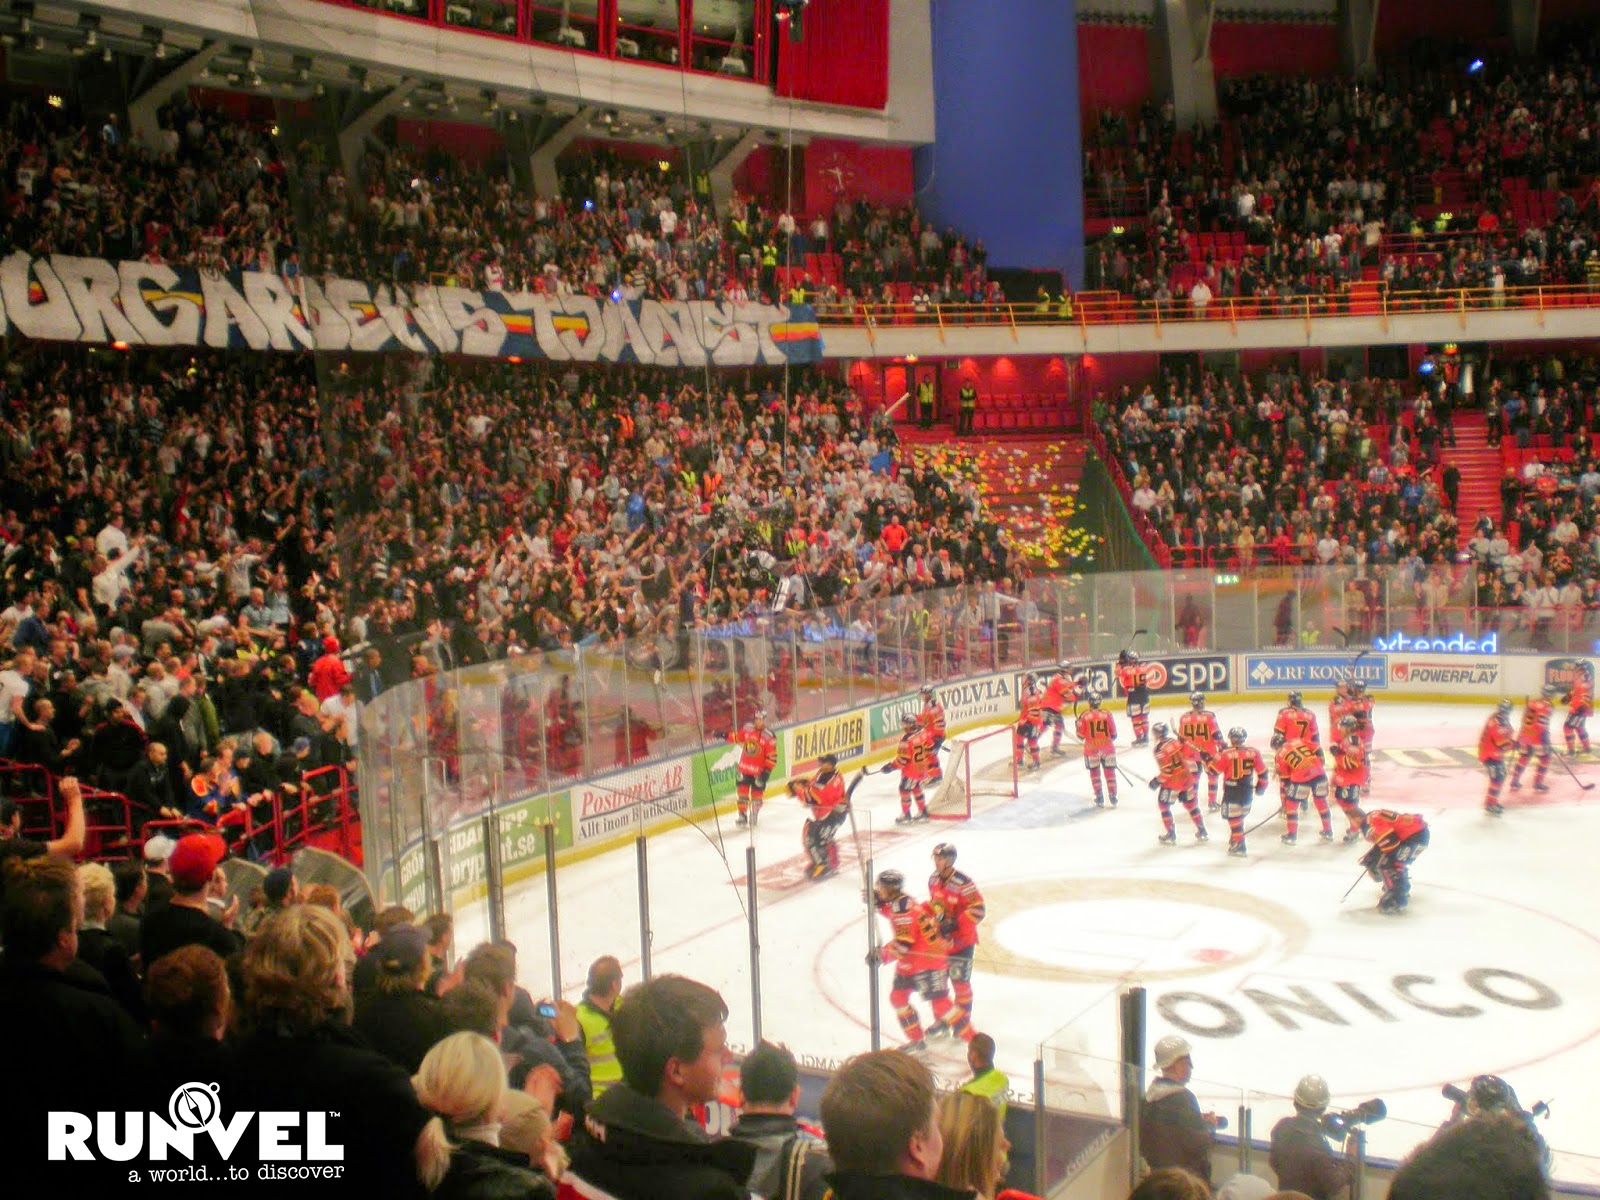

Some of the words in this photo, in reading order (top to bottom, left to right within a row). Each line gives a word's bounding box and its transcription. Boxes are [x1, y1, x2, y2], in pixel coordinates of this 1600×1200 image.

[1172, 661, 1228, 692] spp
[1276, 666, 1305, 680] LRF
[1310, 665, 1384, 681] KONSULT
[1410, 668, 1498, 684] POWERPLAY
[939, 678, 1010, 709] VOLVIA
[795, 718, 863, 761] BLÅKLÄDER
[1089, 719, 1108, 738] 14
[1183, 723, 1209, 741] 44
[1296, 720, 1309, 738] 7
[582, 774, 658, 816] Postronic
[662, 764, 683, 793] AB
[578, 821, 600, 839] Allt
[603, 813, 629, 833] inom
[1156, 967, 1564, 1039] ONICO
